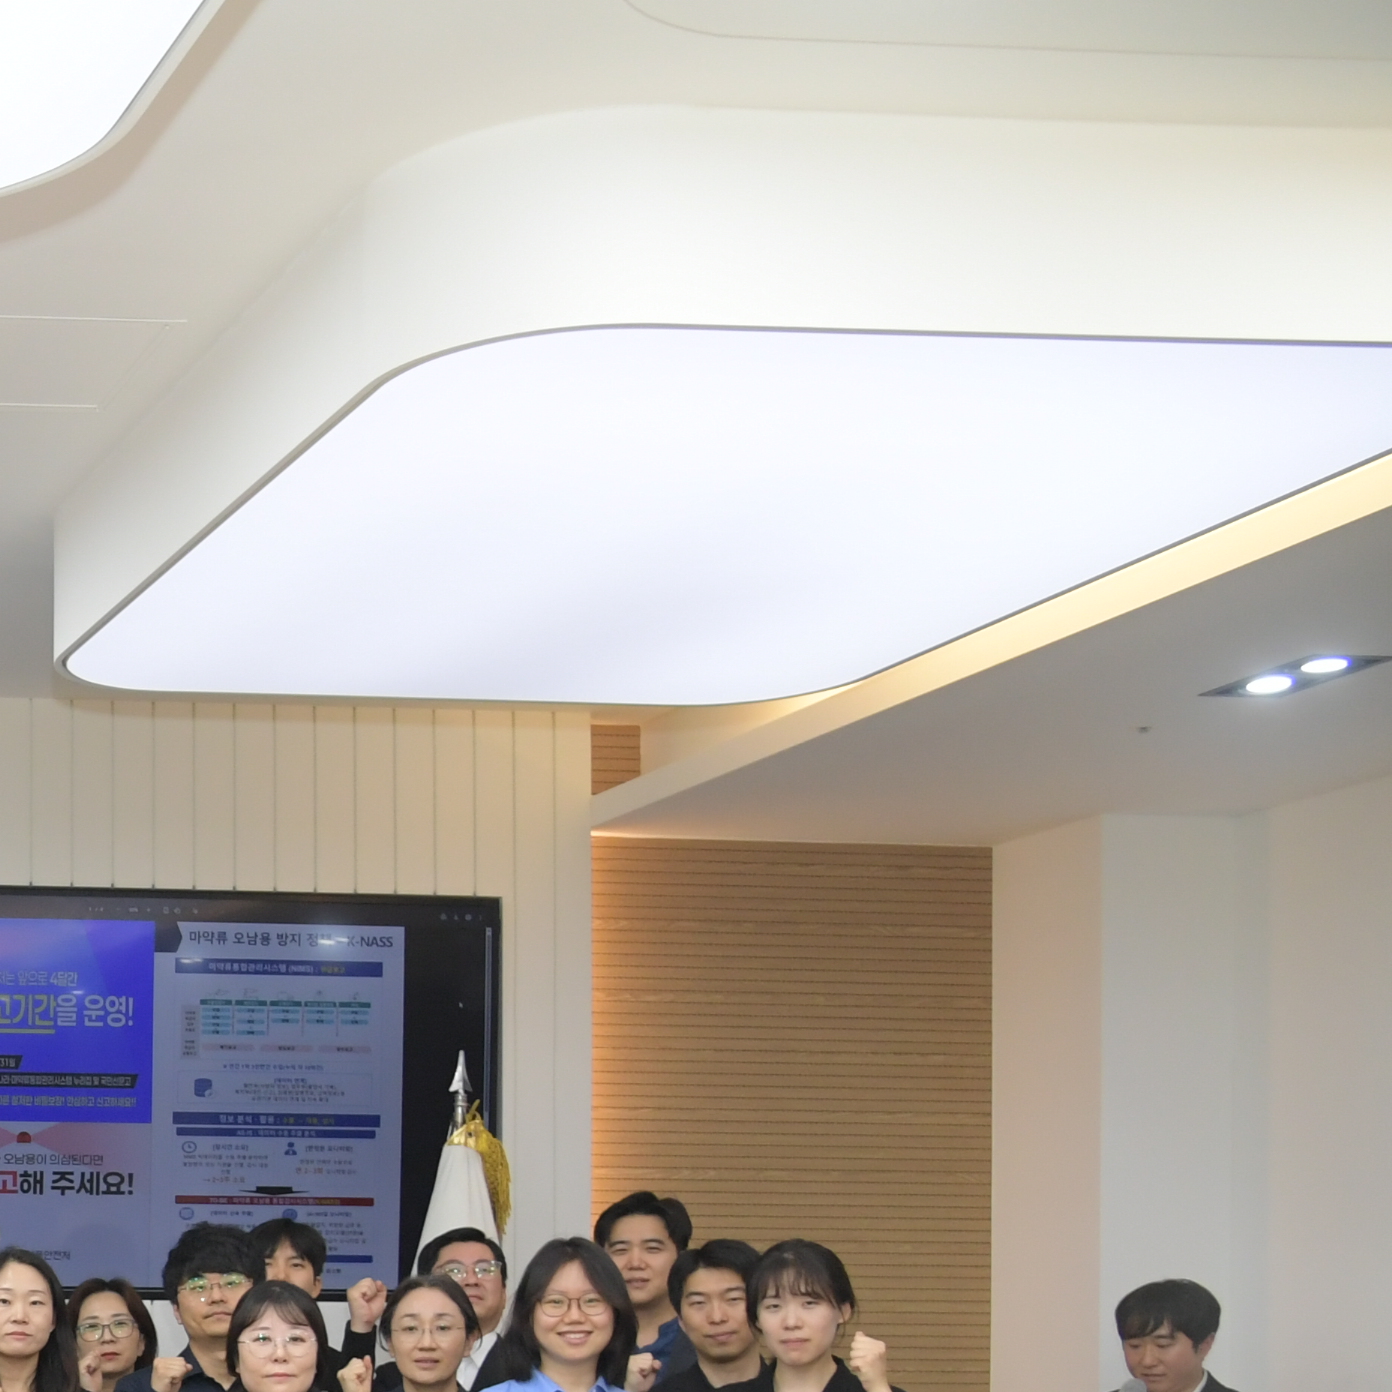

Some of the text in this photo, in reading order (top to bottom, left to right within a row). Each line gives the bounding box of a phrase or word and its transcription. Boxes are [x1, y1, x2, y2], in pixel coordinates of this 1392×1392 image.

[189, 930, 228, 946] 마약류
[232, 931, 271, 947] 오남용
[276, 933, 302, 947] 방지
[18, 971, 48, 986] 앞으로
[50, 972, 78, 987] 4달간
[83, 995, 134, 1028] 운영!
[3, 1154, 47, 1165] 오남용이
[49, 1154, 104, 1166] 의심된다면
[51, 1171, 134, 1196] 주세요!
